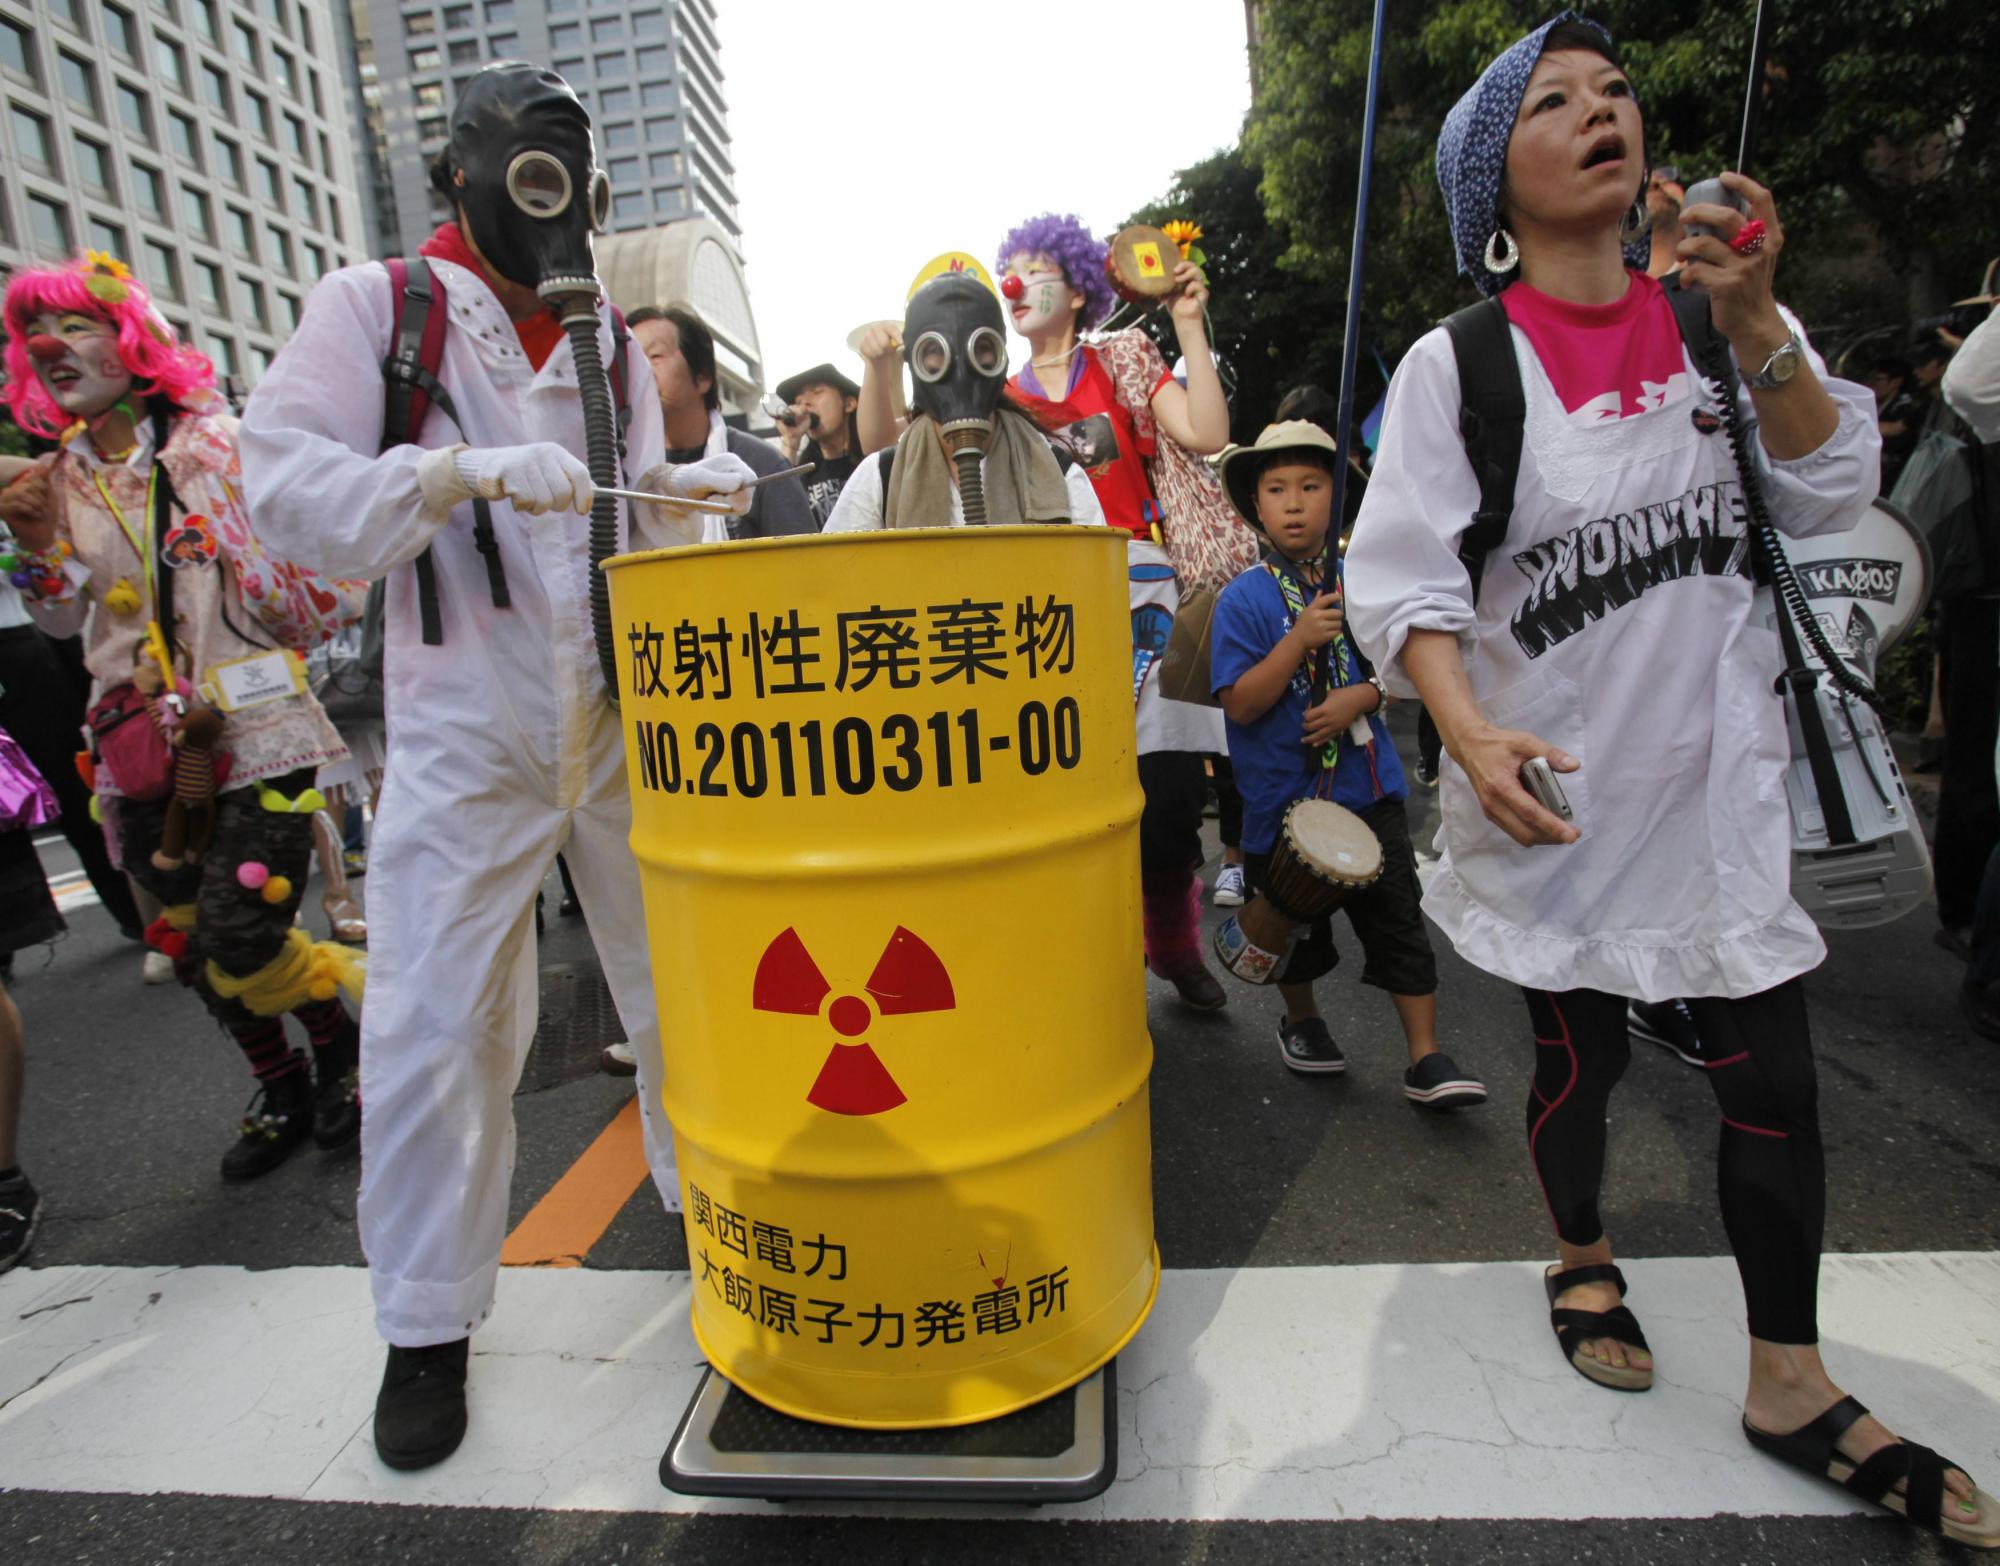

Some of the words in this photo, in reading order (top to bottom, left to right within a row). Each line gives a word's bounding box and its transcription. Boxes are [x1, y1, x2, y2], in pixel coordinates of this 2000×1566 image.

[628, 594, 1075, 701] 放射性廃棄物
[636, 696, 1080, 799] NO.20110311-00
[688, 1181, 847, 1281] 関西電力
[697, 1249, 1069, 1348] 大飯原子力発電所
